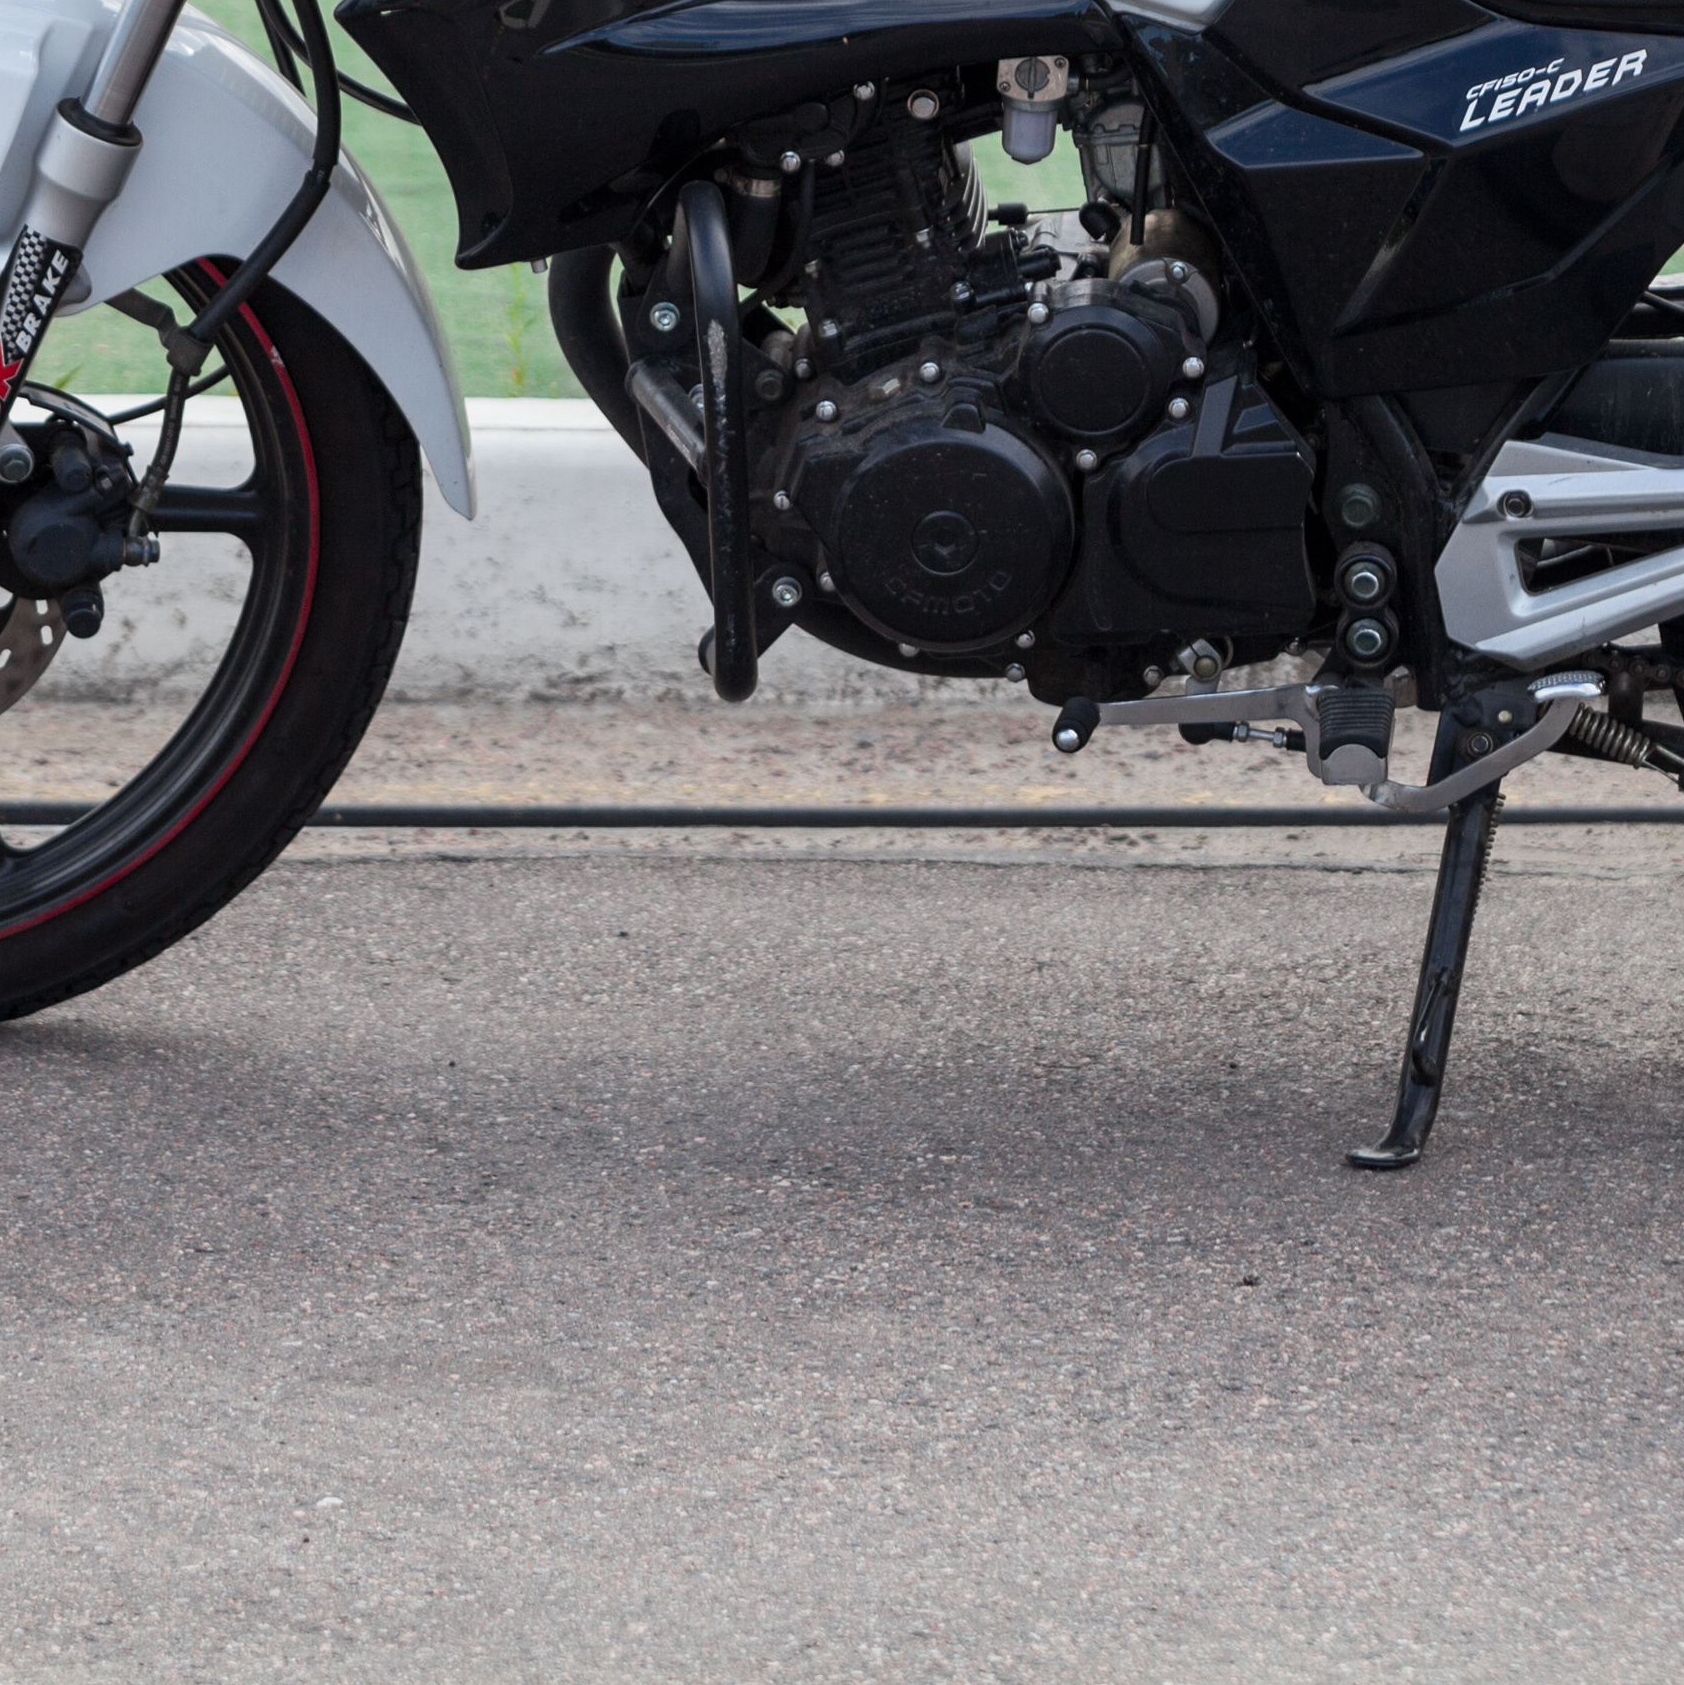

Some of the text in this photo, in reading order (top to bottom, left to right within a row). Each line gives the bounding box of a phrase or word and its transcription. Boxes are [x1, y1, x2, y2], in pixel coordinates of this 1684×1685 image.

[1459, 48, 1648, 132] LEADER
[1465, 56, 1565, 101] CF150-C
[14, 248, 70, 356] BRAKE
